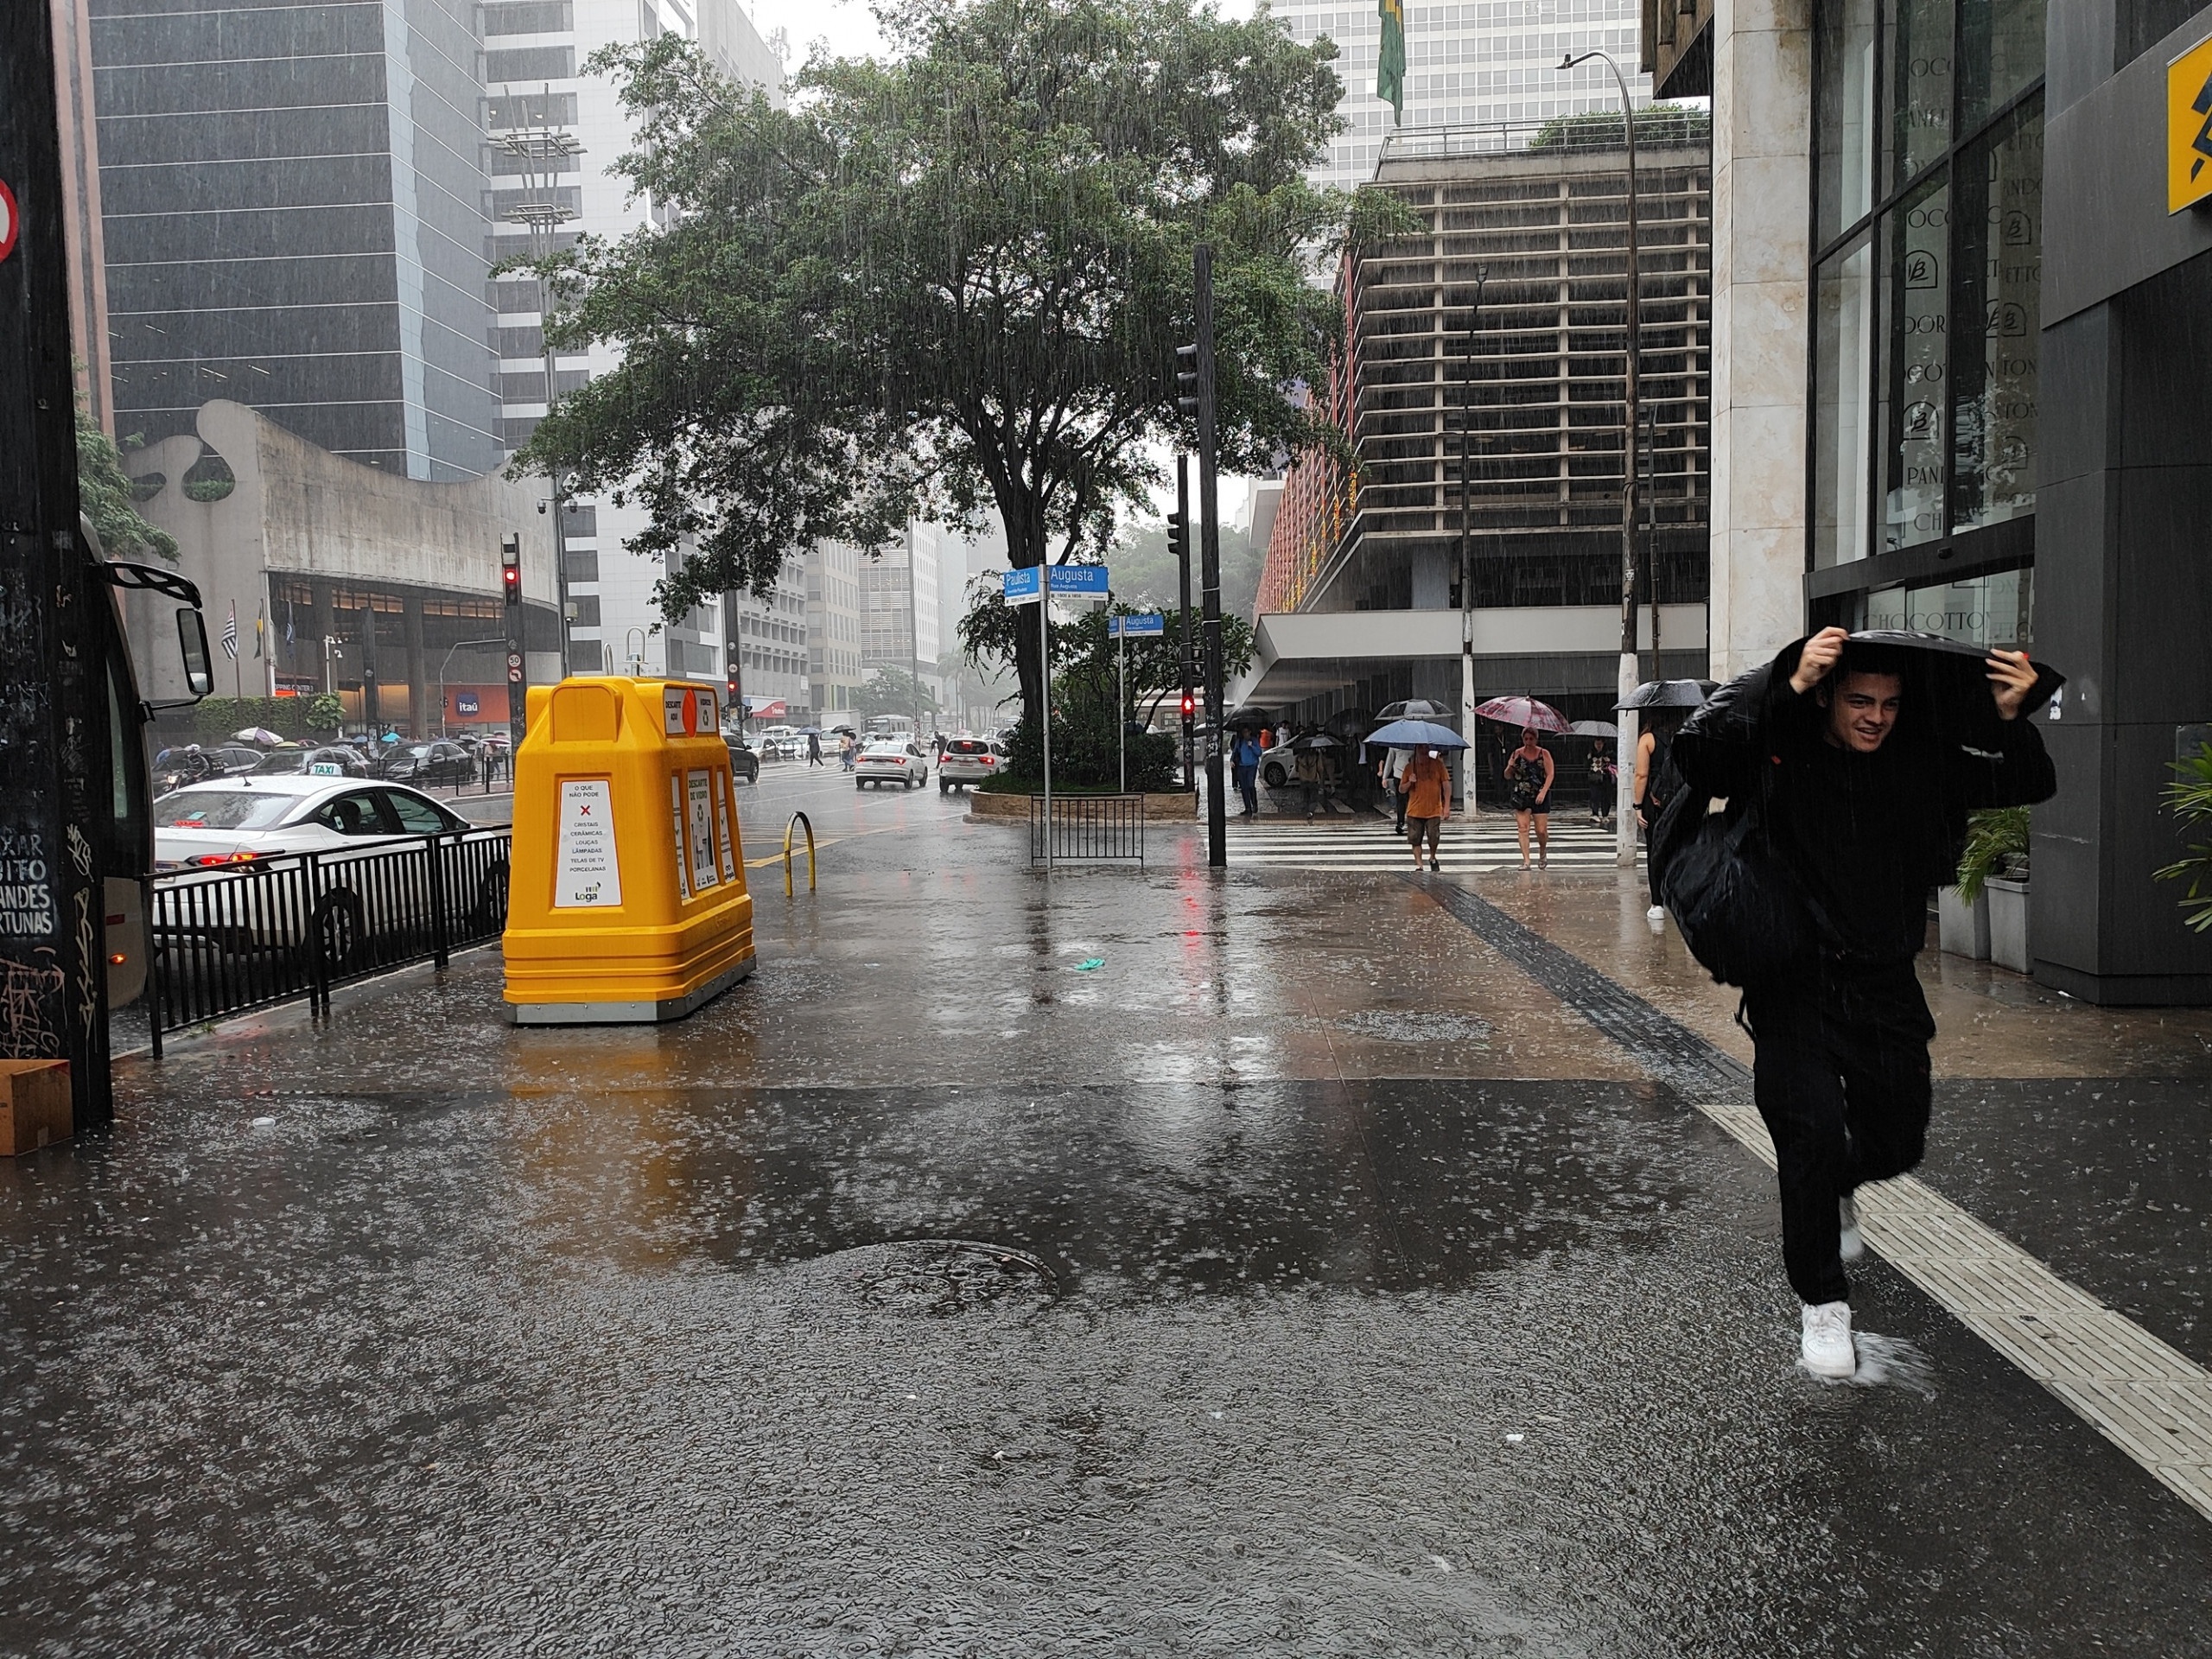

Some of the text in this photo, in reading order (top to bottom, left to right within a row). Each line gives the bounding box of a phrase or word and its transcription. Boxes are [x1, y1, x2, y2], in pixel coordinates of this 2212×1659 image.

[1907, 466, 1944, 486] PAN
[1006, 571, 1031, 587] Paulista
[1051, 568, 1094, 582] Augusta
[1126, 616, 1154, 626] Augusta
[459, 702, 478, 712] itaú
[315, 766, 334, 775] TAXI
[689, 779, 708, 789] DESCARTE
[690, 791, 696, 800] DE
[575, 892, 598, 903] Loga
